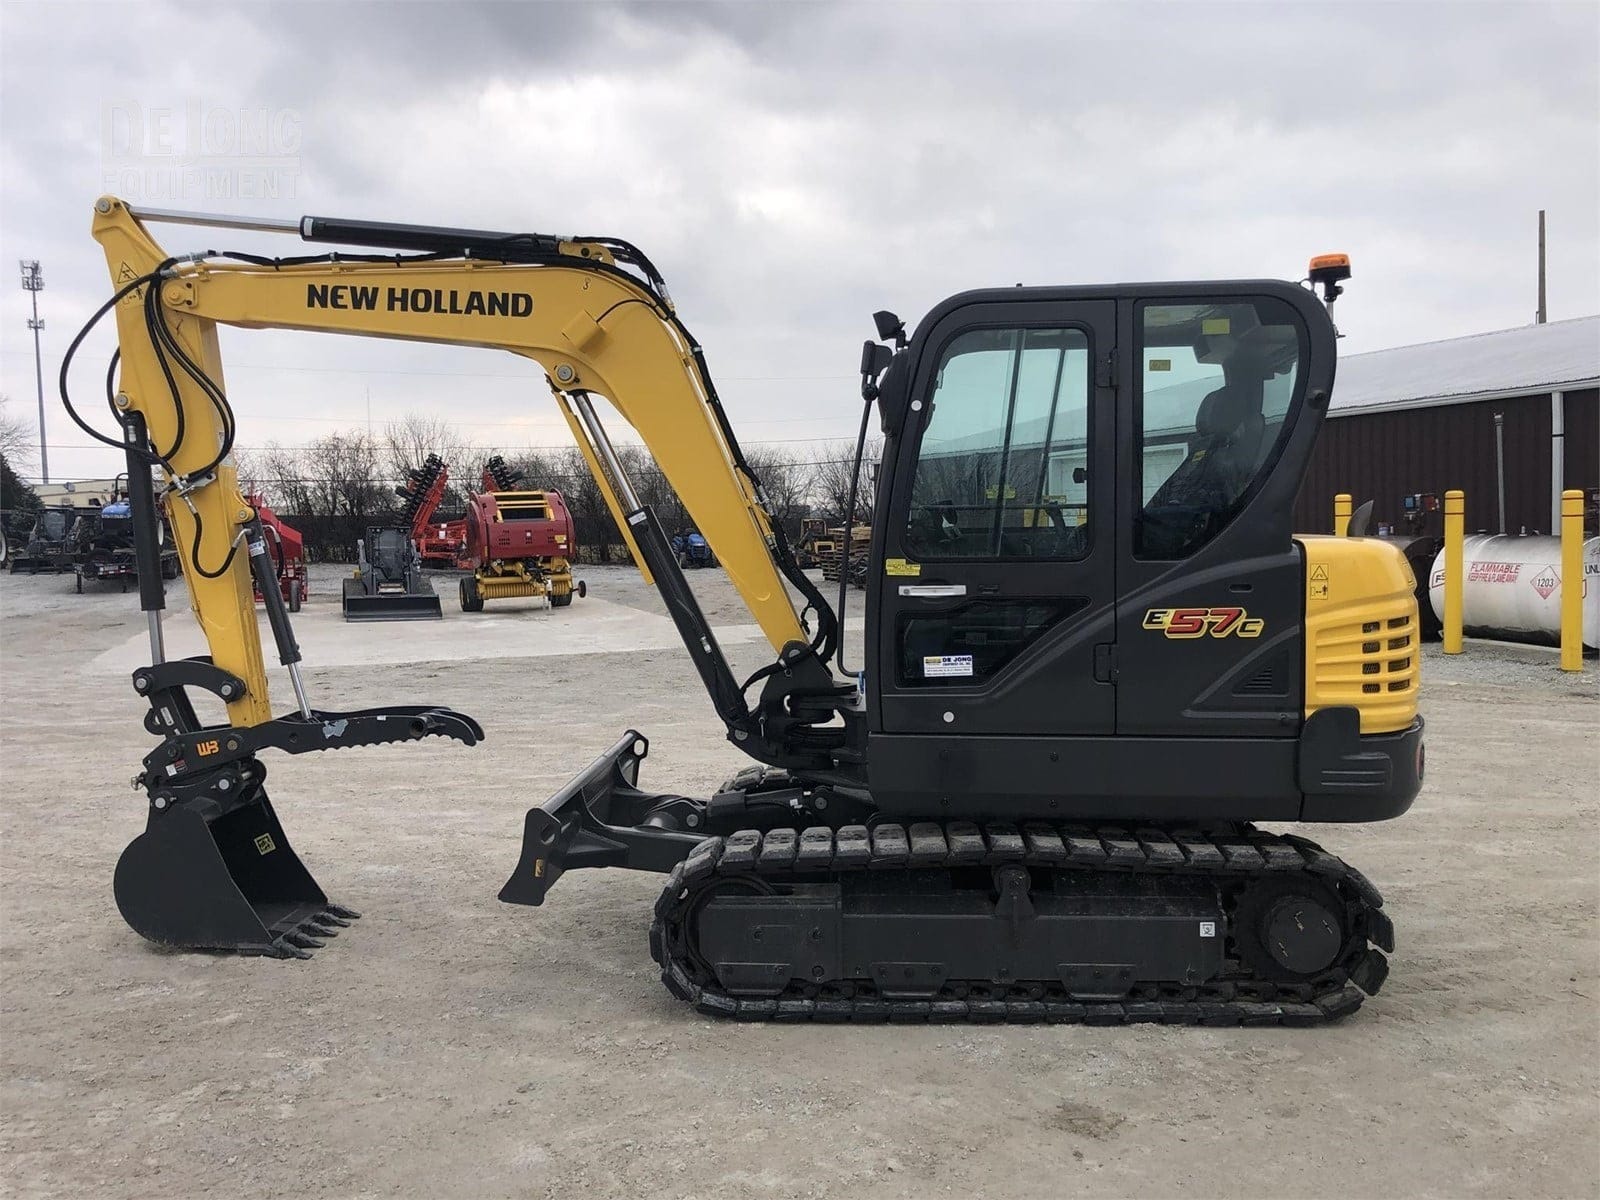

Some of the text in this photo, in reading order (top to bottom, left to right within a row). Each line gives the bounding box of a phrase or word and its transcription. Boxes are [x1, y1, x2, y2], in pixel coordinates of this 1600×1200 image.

[307, 284, 533, 317] NEW HOLLAND
[1470, 563, 1521, 574] FLAMMABLE
[1537, 578, 1554, 587] 1203
